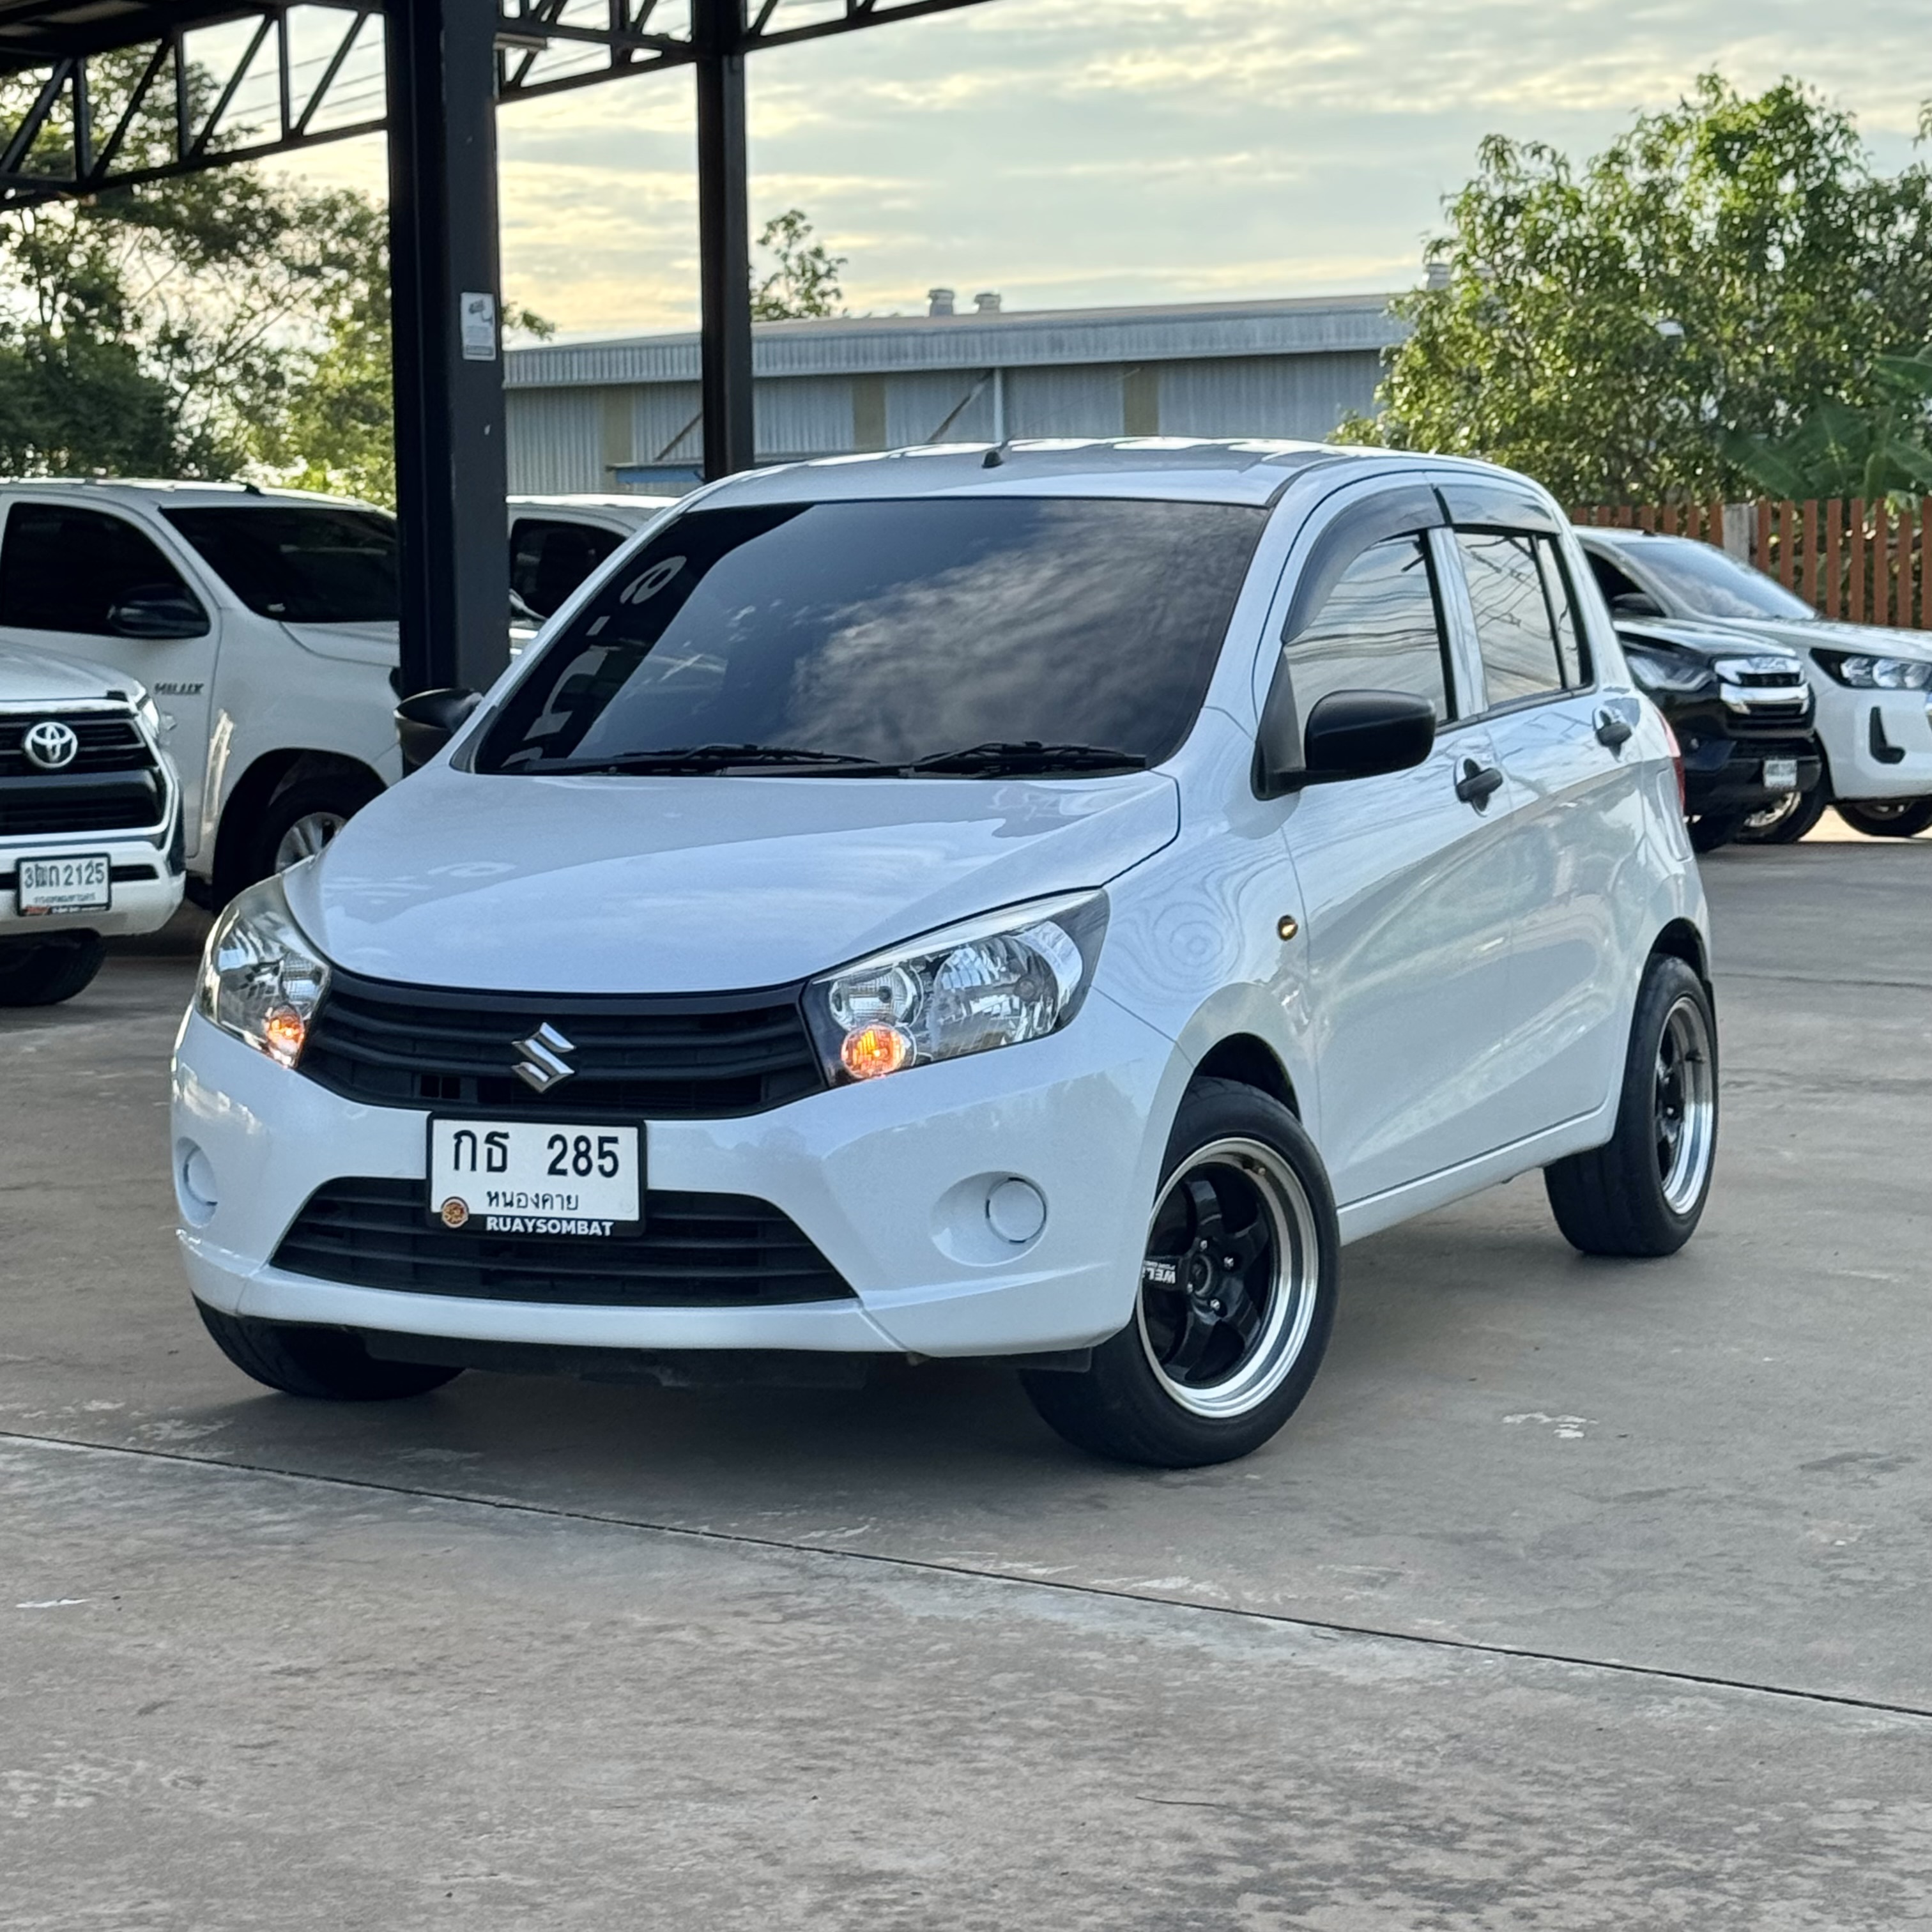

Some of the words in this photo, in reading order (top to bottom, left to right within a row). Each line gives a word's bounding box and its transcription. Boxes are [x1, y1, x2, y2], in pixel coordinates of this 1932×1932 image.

[63, 860, 105, 887] 2125
[453, 1130, 510, 1173] กธ
[547, 1133, 619, 1178] 285
[486, 1190, 579, 1211] หนองคาย
[486, 1216, 614, 1236] RUAYSOMBAT
